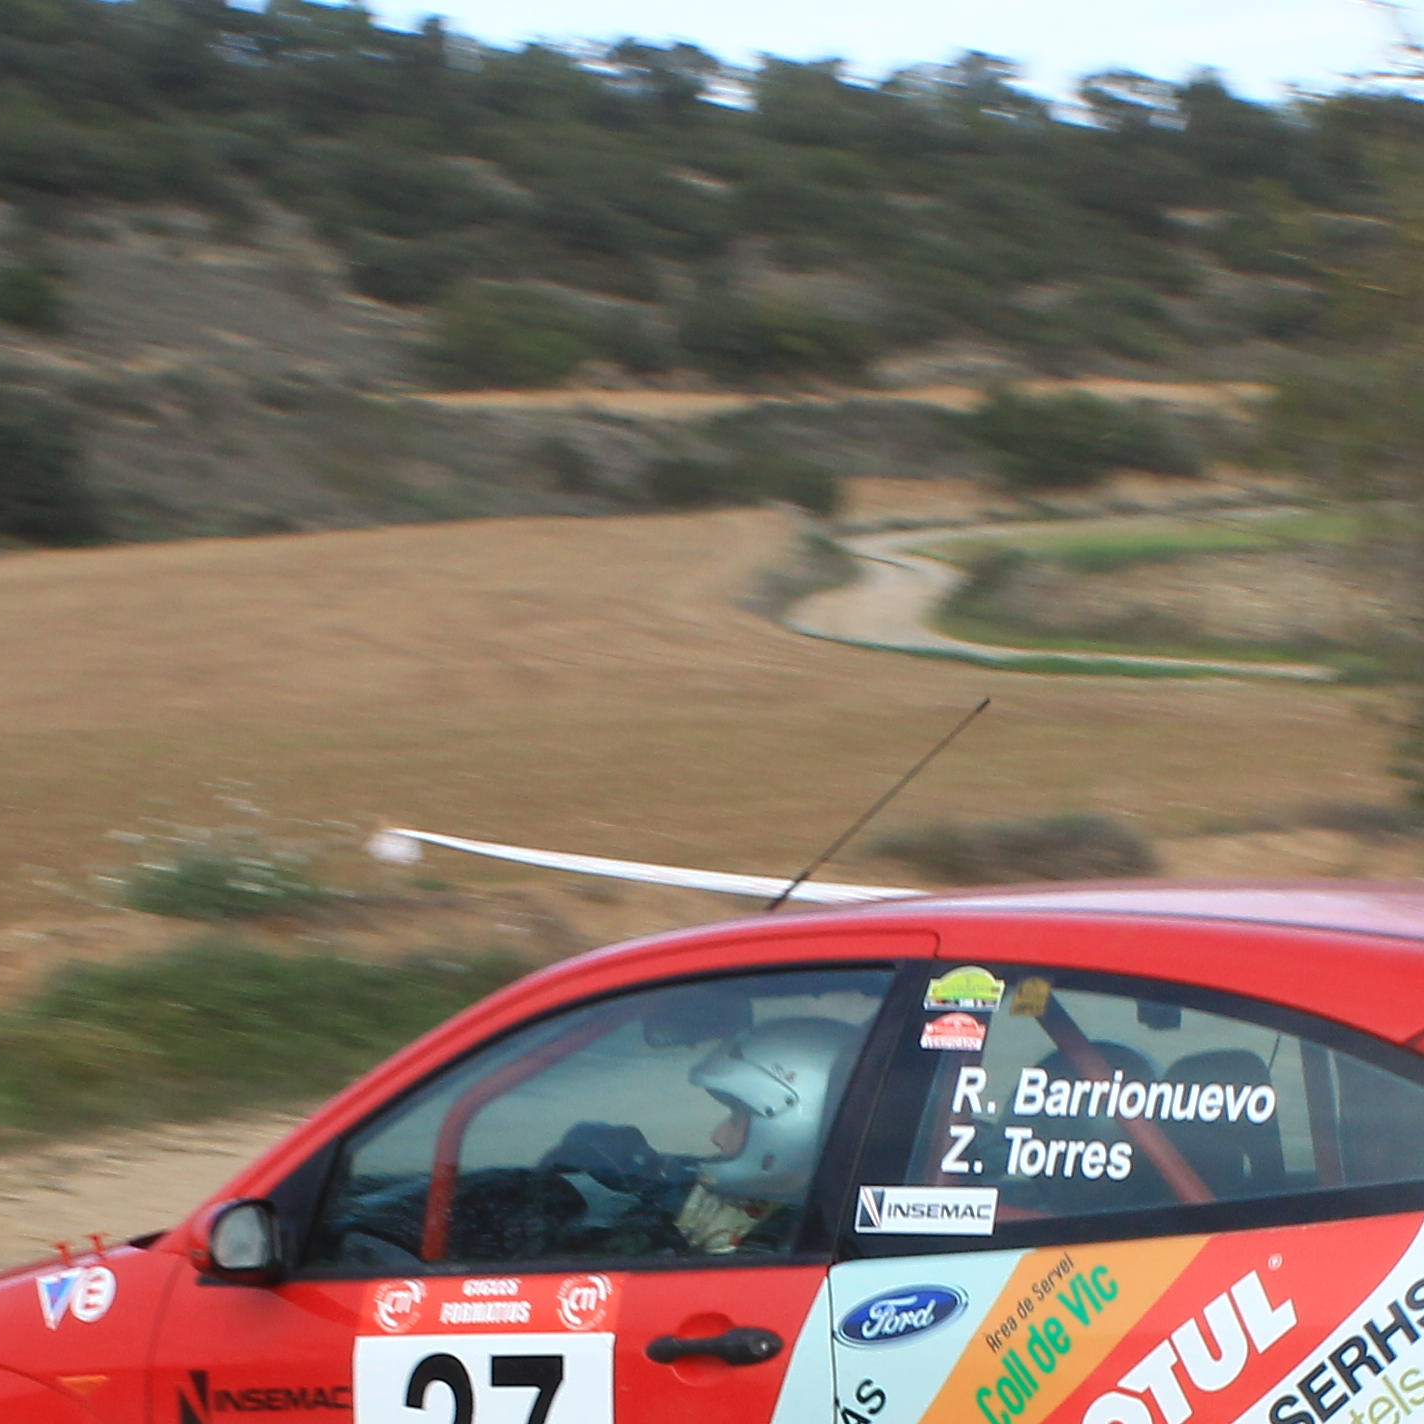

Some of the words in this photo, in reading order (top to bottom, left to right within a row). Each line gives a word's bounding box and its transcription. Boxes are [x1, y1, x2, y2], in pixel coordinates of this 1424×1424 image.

[951, 1066, 996, 1116] R.
[1013, 1067, 1277, 1124] Barrionuevo
[941, 1125, 984, 1175] Z.
[1004, 1127, 1133, 1181] Torres
[886, 1201, 994, 1221] INSEMAC
[861, 1295, 936, 1339] Ford
[1017, 1297, 1035, 1320] de
[1027, 1317, 1071, 1374] de
